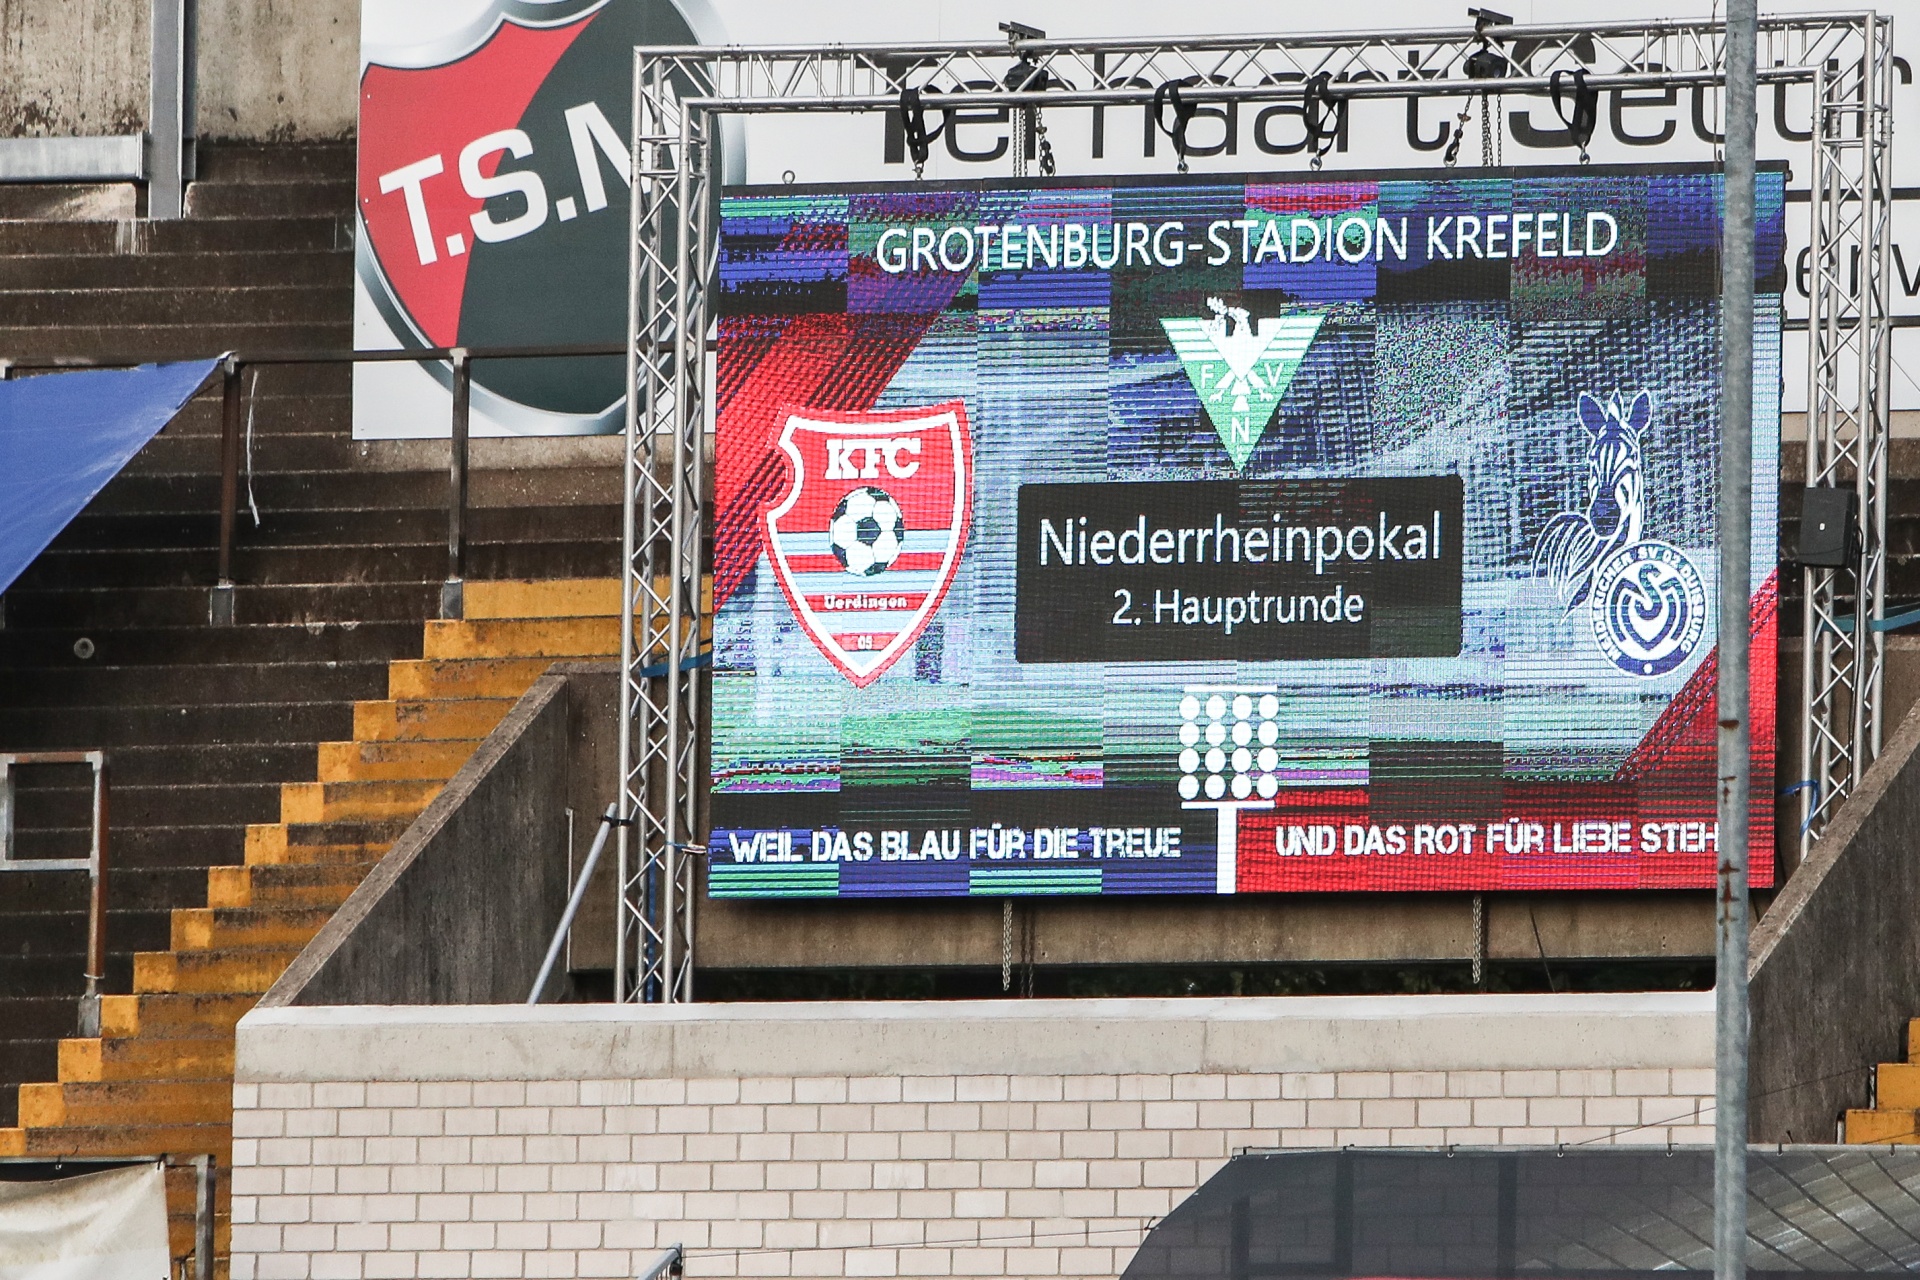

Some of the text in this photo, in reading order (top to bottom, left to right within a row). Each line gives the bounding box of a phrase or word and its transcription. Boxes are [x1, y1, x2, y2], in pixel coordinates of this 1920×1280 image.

[876, 211, 1618, 273] GROTENBURG-STADION KREFELD
[825, 437, 922, 480] KFC
[1039, 510, 1441, 575] Niederrheinpokal
[1637, 546, 1659, 561] SV
[1662, 549, 1682, 569] 02
[1111, 585, 1364, 635] 2. Hauptrunde
[728, 821, 1182, 863] WEIL DAS BLAU FÜR DIE TREUE
[1275, 825, 1337, 856] UND
[1343, 824, 1407, 856] DAS
[1414, 823, 1477, 855] ROT
[1485, 816, 1546, 854] FÜR
[1553, 821, 1633, 853] LIEBE
